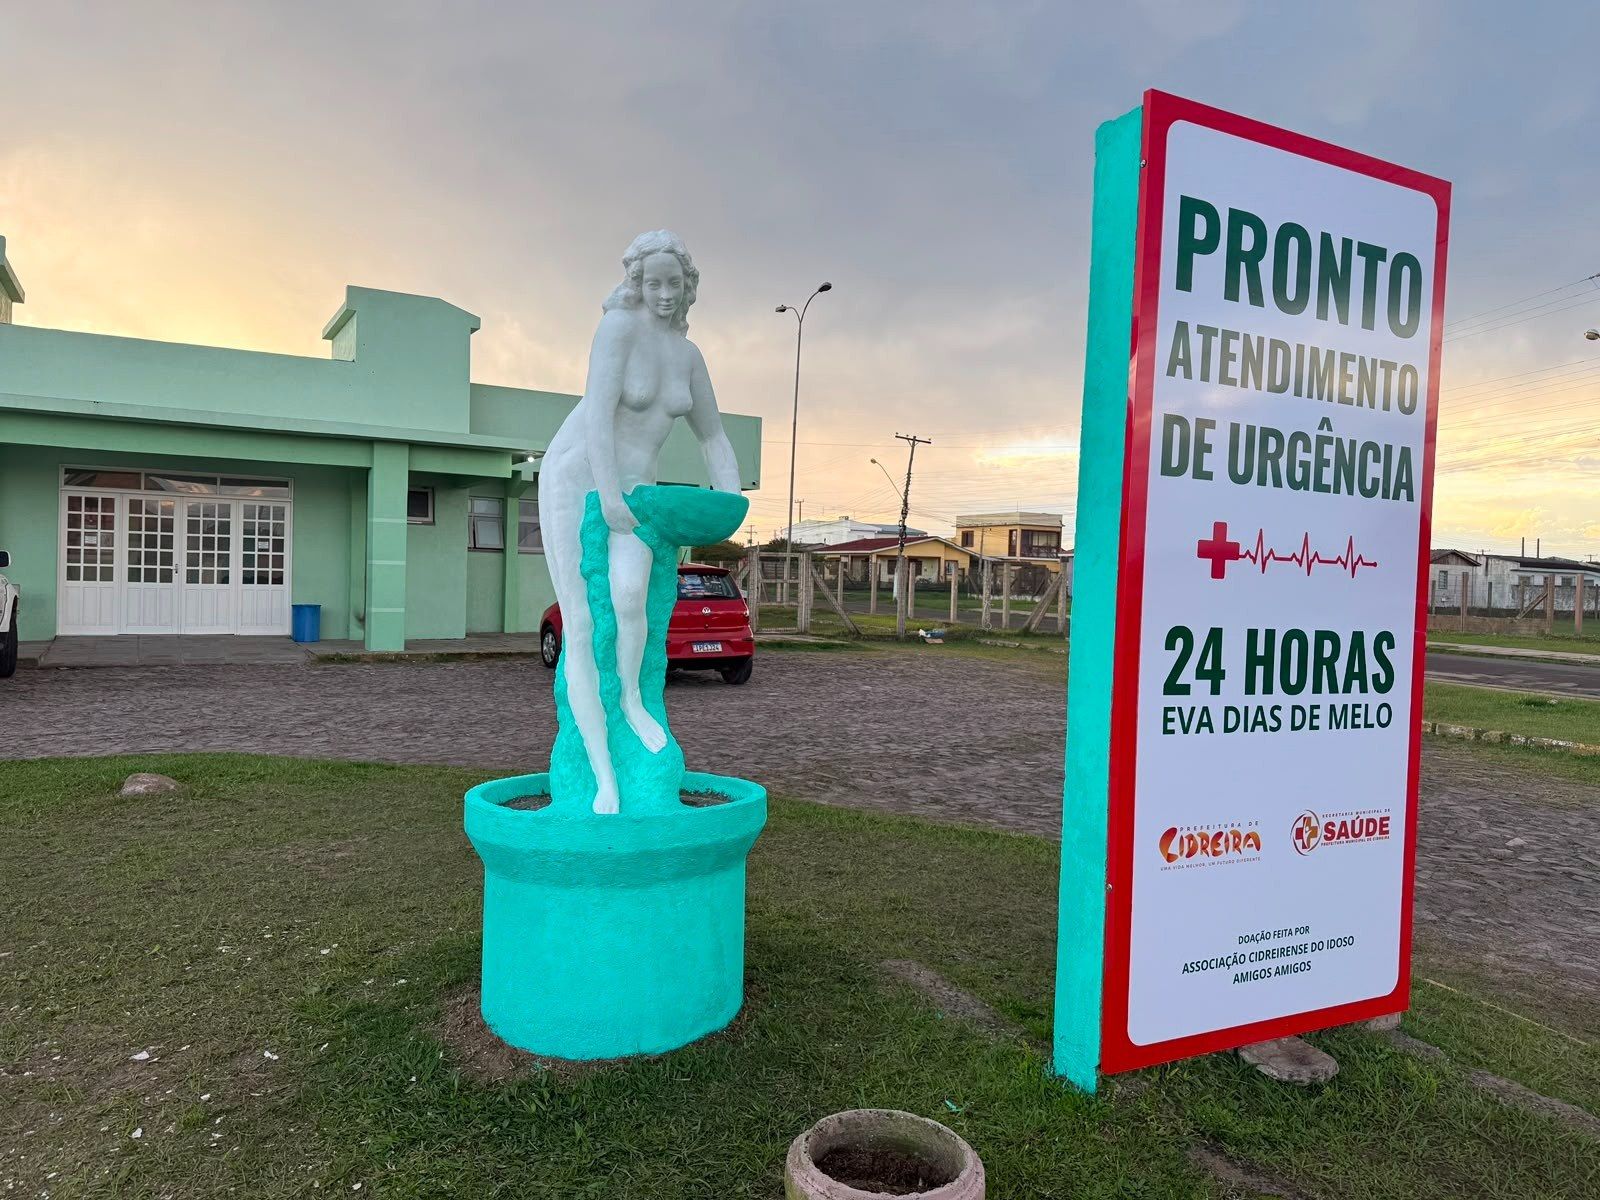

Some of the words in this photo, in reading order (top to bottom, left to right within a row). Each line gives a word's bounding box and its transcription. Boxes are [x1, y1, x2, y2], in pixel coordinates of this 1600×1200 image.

[1175, 194, 1423, 339] PRONTO
[1166, 320, 1419, 415] ATENDIMENTO
[1160, 413, 1216, 481] DE
[1227, 416, 1415, 502] URGÊNCIA
[1163, 625, 1226, 695] 24
[1244, 628, 1396, 695] HORAS
[1162, 706, 1214, 735] EVA
[1223, 705, 1282, 734] DIAS
[1290, 704, 1321, 731] DE
[1328, 702, 1393, 730] MELO
[1158, 827, 1261, 863] CIDREIRA
[1180, 822, 1241, 832] PREFEITURA
[1323, 815, 1391, 841] SAÚDE
[1238, 930, 1271, 945] DOAÇÃO
[1273, 927, 1293, 940] FEITA
[1294, 925, 1310, 936] POR
[1182, 952, 1246, 975] ASSOCIAÇÃO
[1248, 943, 1309, 963] CIDREIRENSE
[1310, 940, 1325, 953] DO
[1326, 935, 1355, 950] IDOSO
[1232, 966, 1272, 984] AMIGOS
[1274, 960, 1312, 977] AMIGOS
